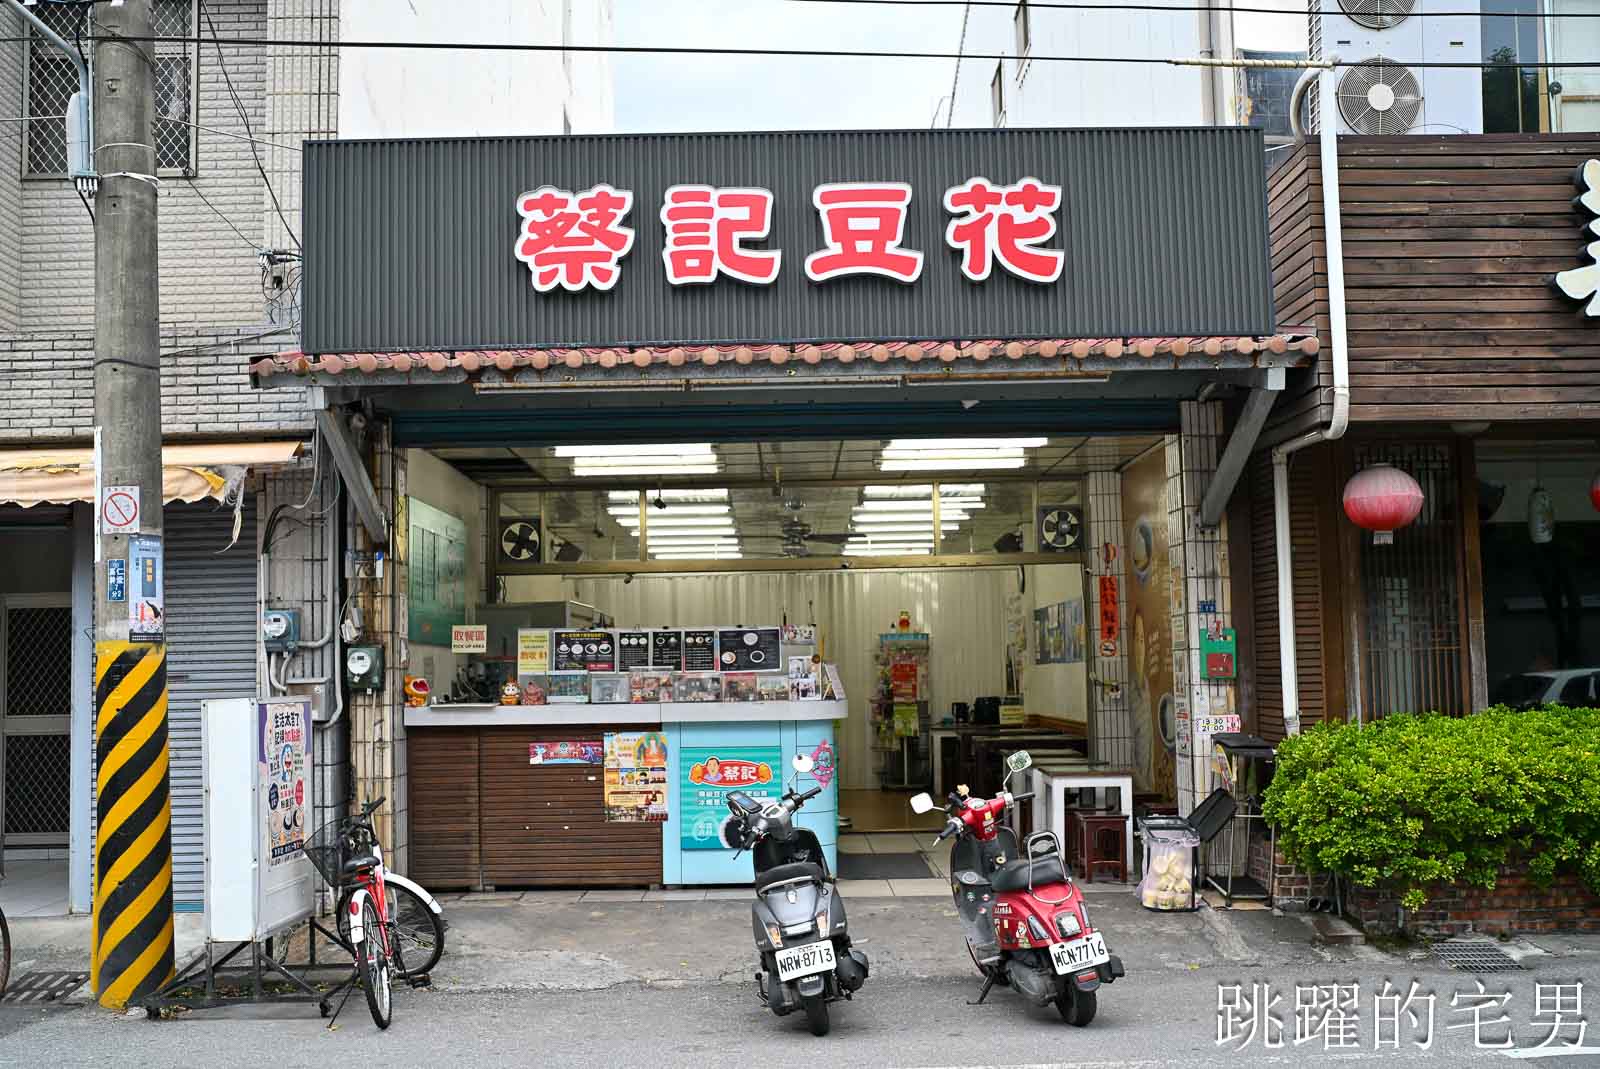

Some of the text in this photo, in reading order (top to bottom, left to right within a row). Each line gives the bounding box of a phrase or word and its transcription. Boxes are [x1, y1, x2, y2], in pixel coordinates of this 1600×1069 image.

[514, 177, 1064, 292] 蔡記豆花
[454, 630, 485, 641] 取餐區
[274, 711, 300, 728] 生活太苦了
[723, 765, 758, 781] 蔡記
[779, 947, 833, 975] NRW-8713
[1053, 940, 1106, 968] MCN-7716
